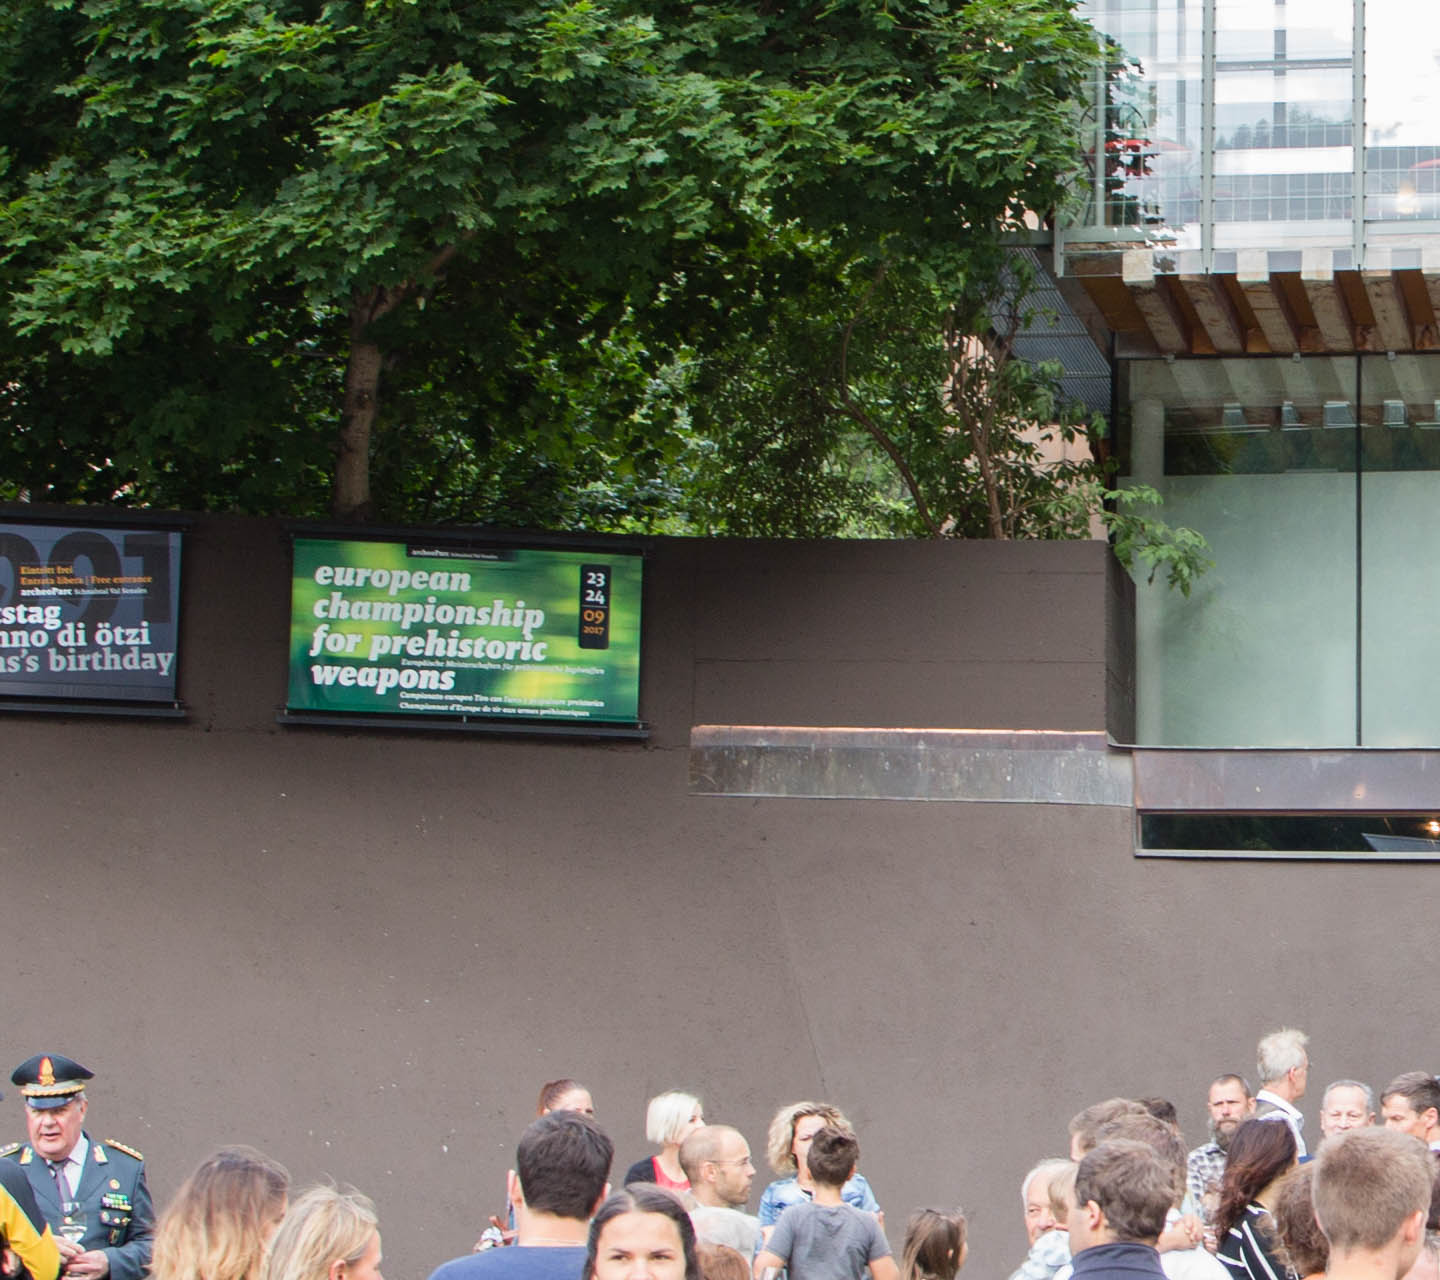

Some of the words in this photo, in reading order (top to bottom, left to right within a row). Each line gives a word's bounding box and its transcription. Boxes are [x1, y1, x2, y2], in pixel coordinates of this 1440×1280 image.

[314, 565, 471, 596] european
[587, 572, 606, 587] 23
[585, 589, 606, 605] 24
[313, 592, 545, 640] championship
[583, 609, 605, 624] 09
[57, 623, 88, 647] di
[95, 621, 151, 646] ötzi
[309, 623, 362, 656] for
[368, 629, 548, 661] prehistoric
[583, 625, 605, 635] 2017
[49, 648, 175, 676] birthday
[310, 664, 456, 695] weapons
